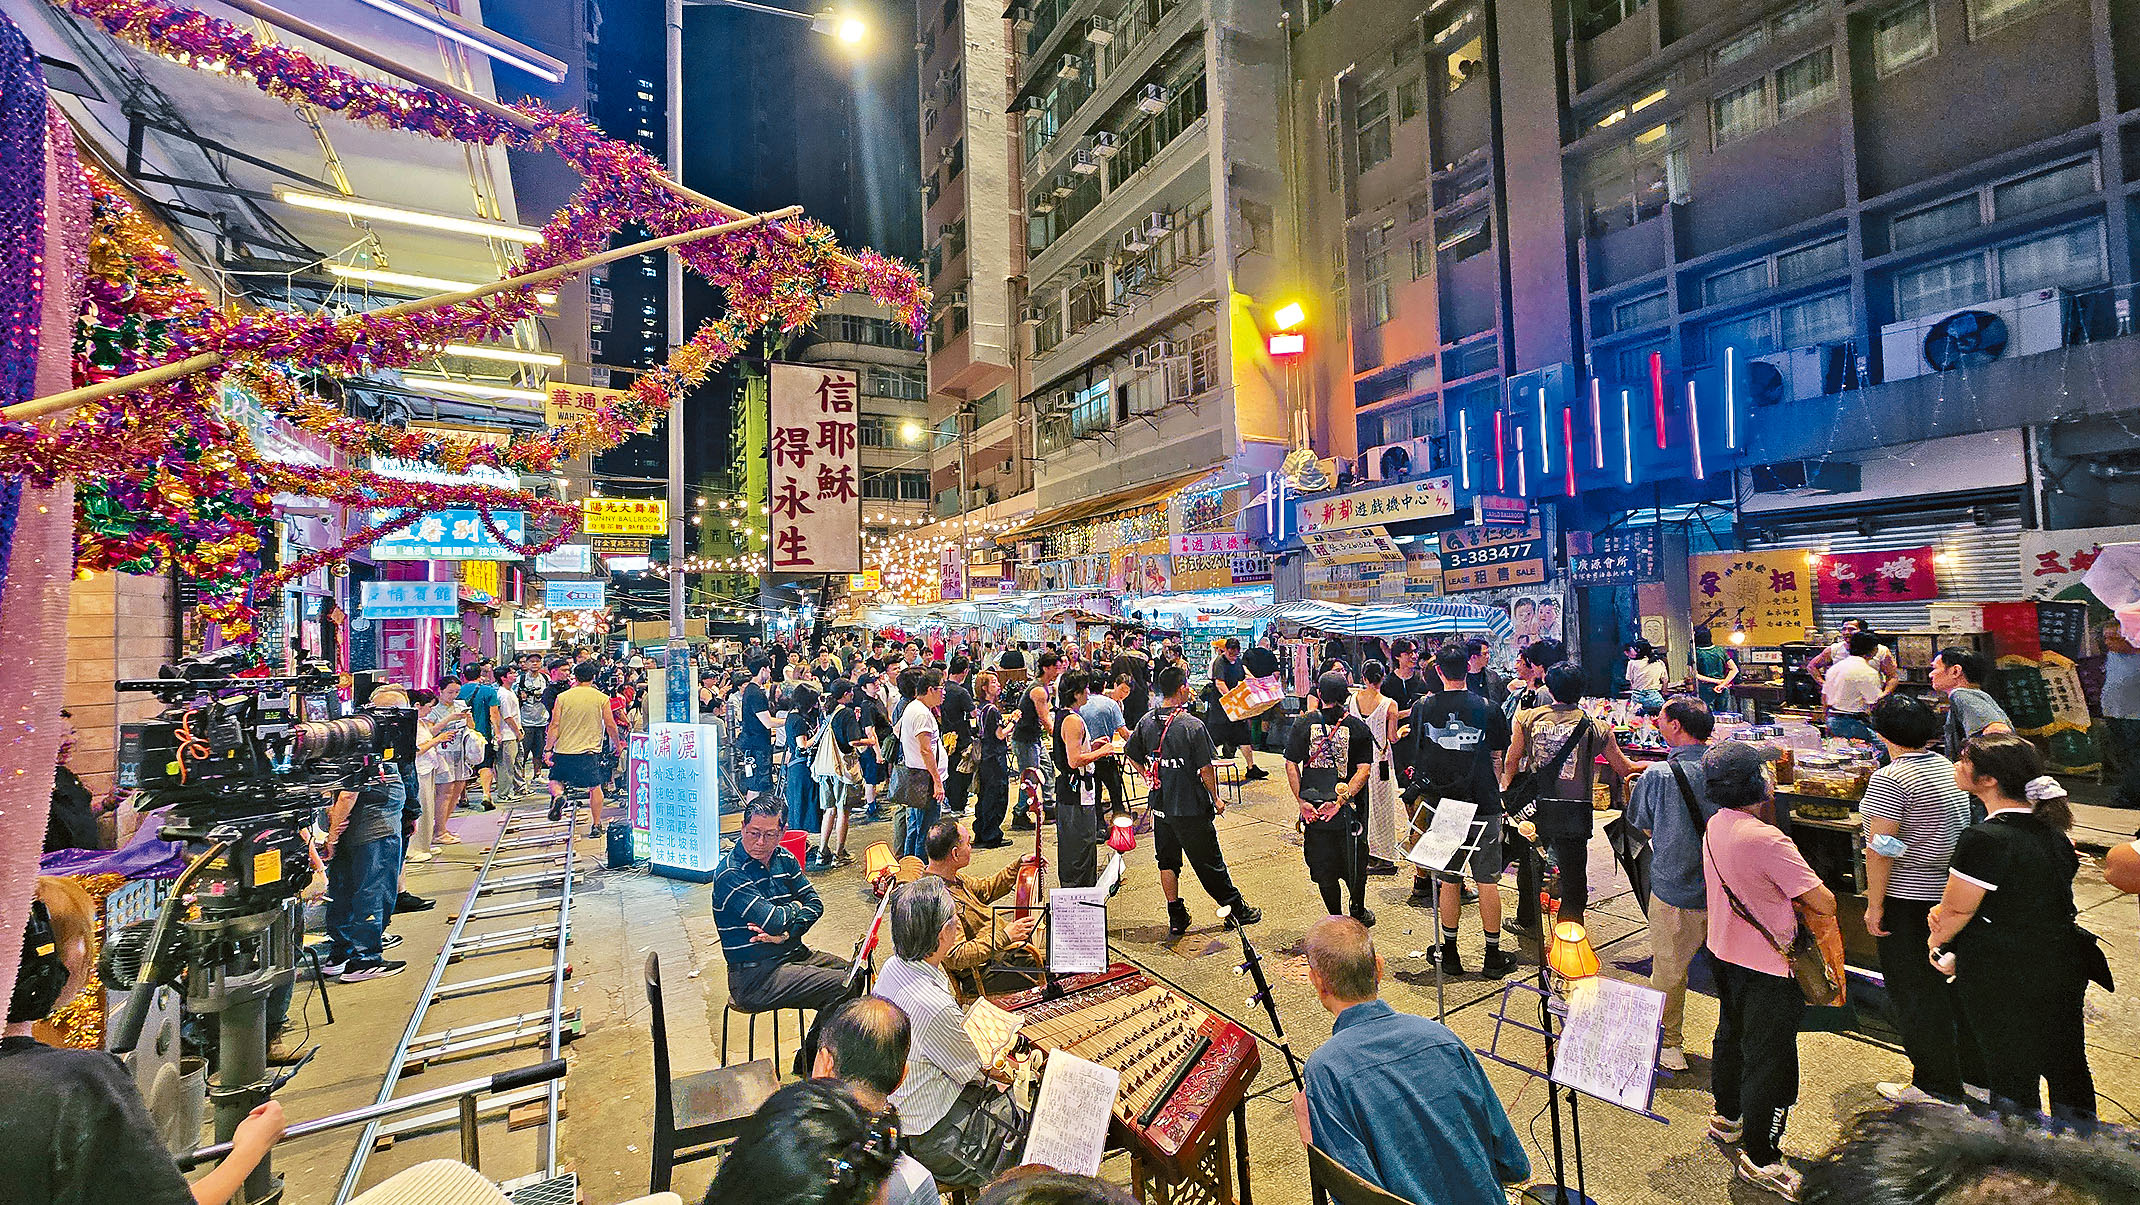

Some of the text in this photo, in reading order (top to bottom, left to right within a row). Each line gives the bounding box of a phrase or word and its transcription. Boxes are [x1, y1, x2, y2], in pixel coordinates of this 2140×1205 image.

[815, 374, 859, 504] 信耶穌
[590, 502, 661, 514] 陽光大舞廳
[771, 426, 815, 567] 得永生
[1321, 494, 1430, 526] 新都遊戲機中心
[1451, 544, 1532, 567] 3-383477
[1448, 567, 1536, 585] LEASE 租 售 SALE
[1768, 568, 1797, 593] 相
[654, 729, 698, 760] 瀟灑
[653, 766, 700, 784] 精選推介
